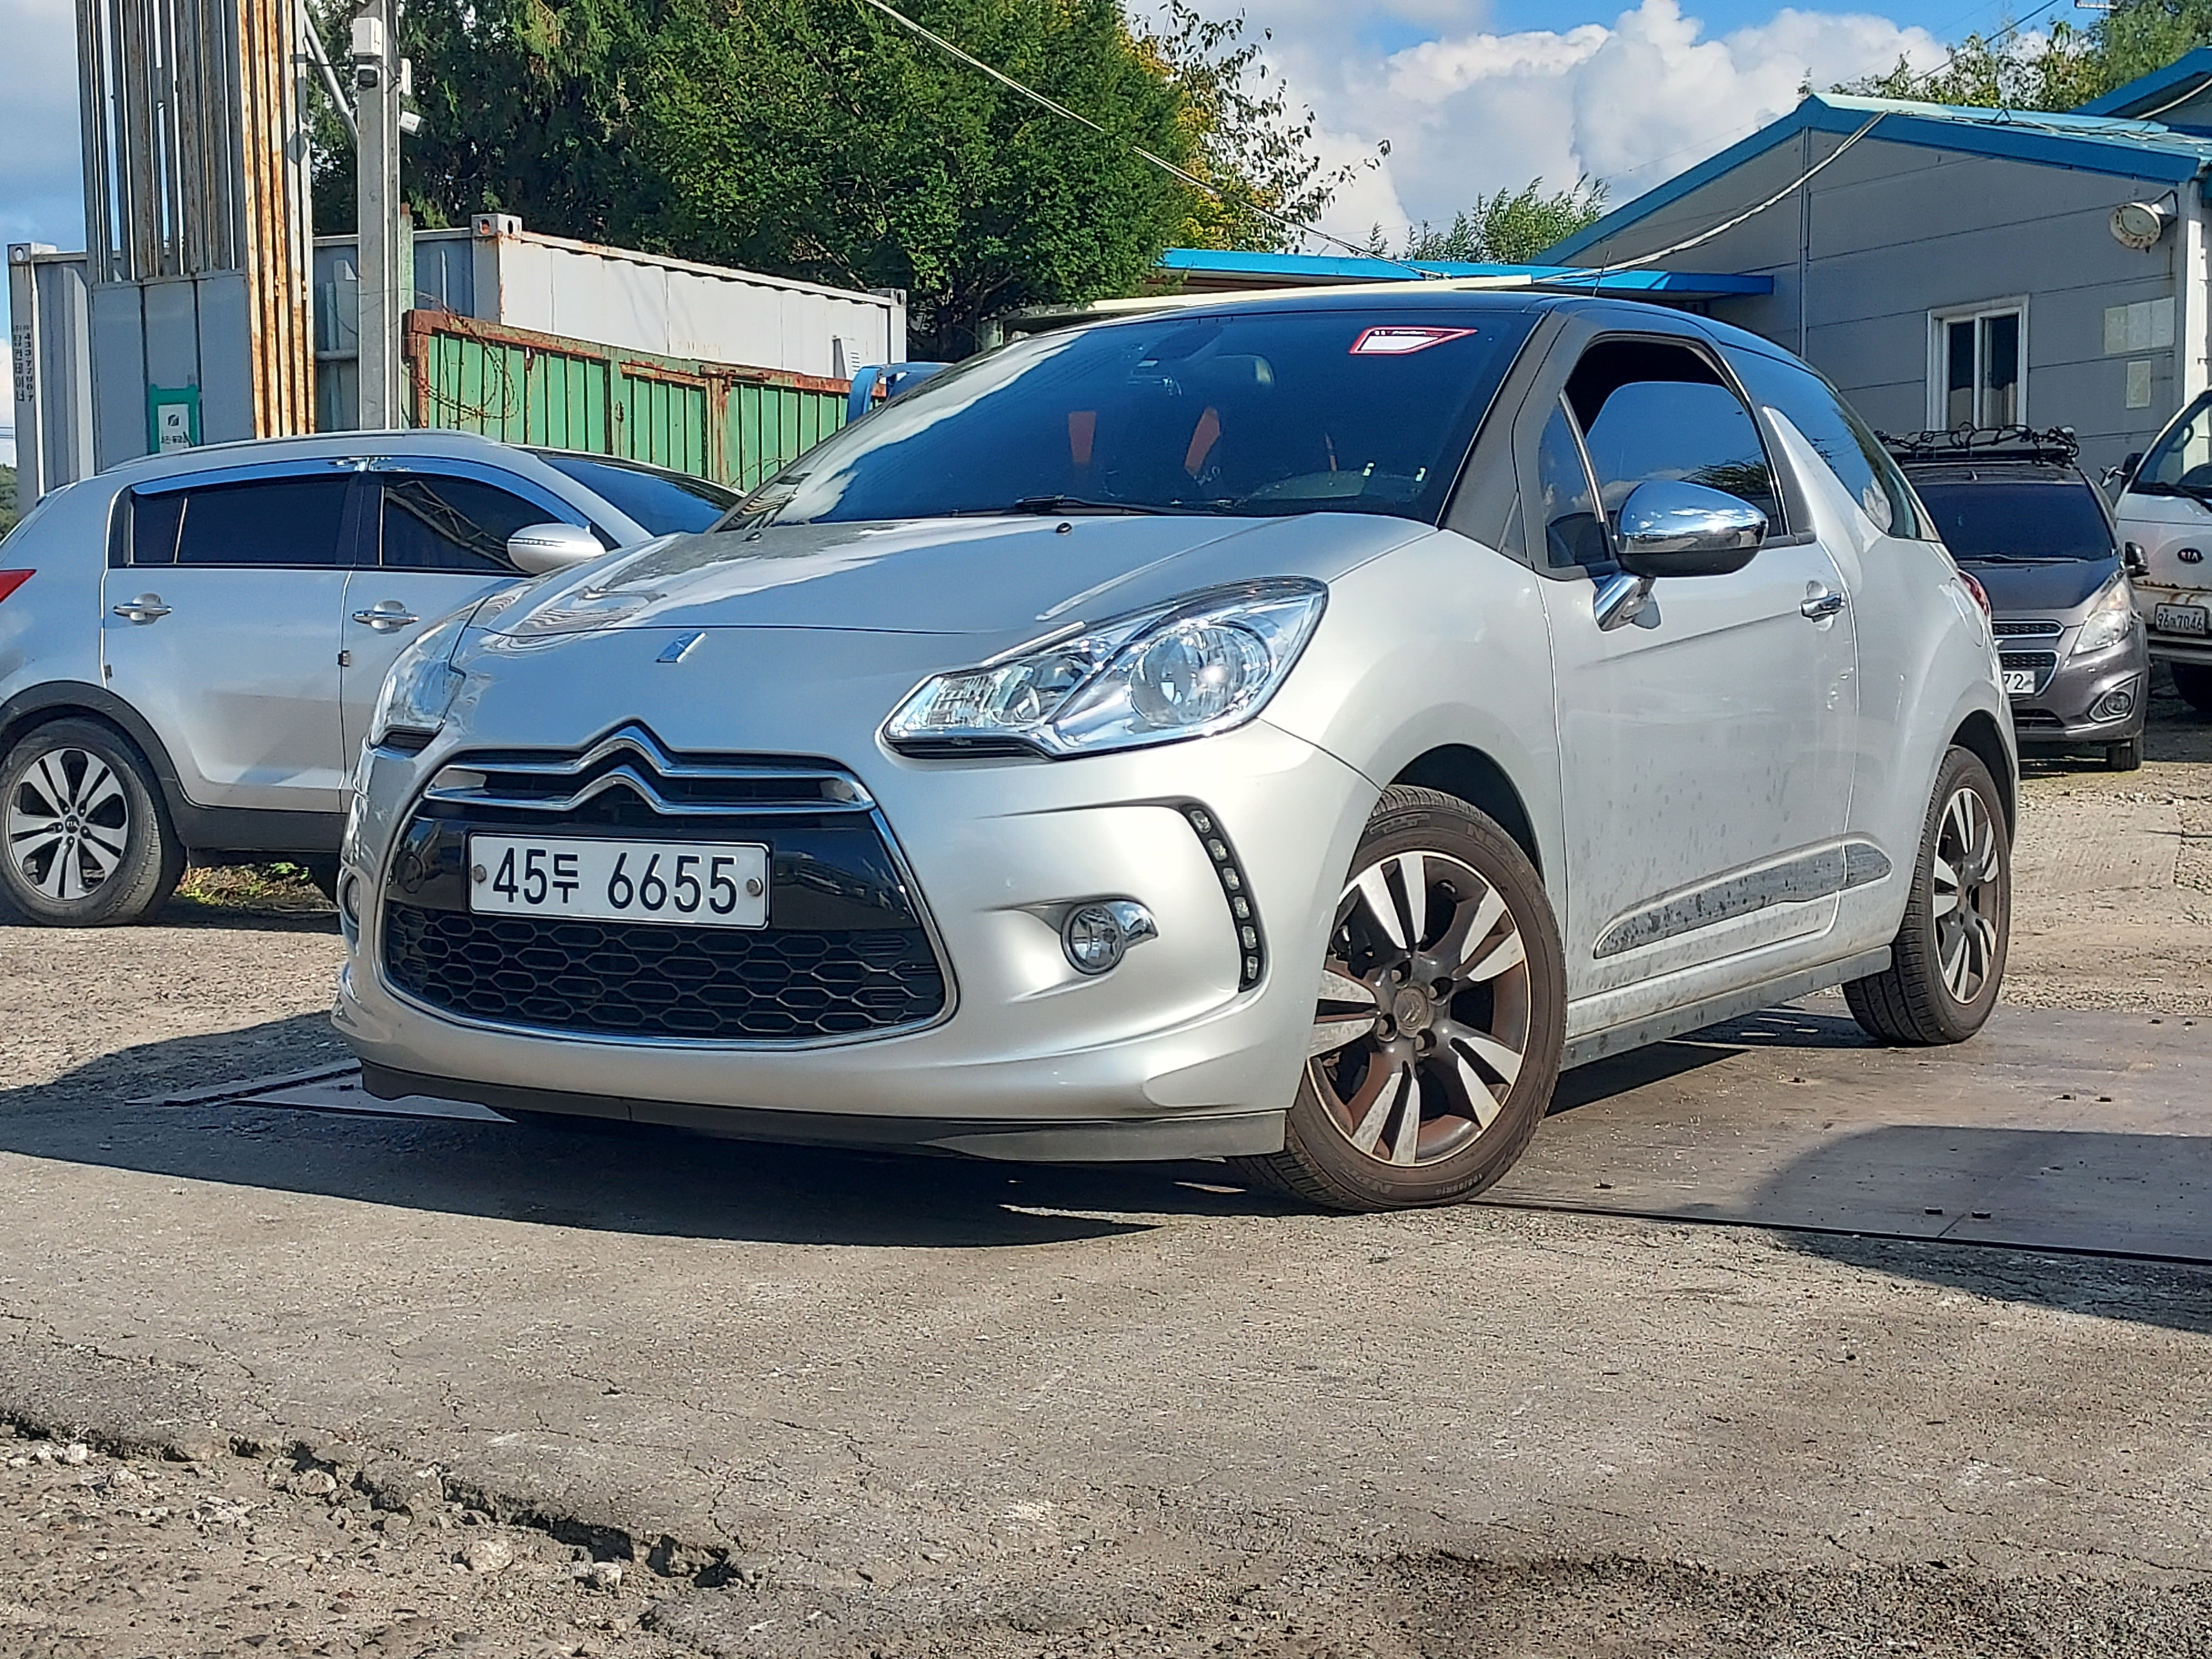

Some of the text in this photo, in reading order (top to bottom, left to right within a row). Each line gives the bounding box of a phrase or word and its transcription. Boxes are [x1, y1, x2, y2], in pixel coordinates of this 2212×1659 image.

[2180, 551, 2199, 562] KIA
[493, 847, 737, 914] 45두 6655
